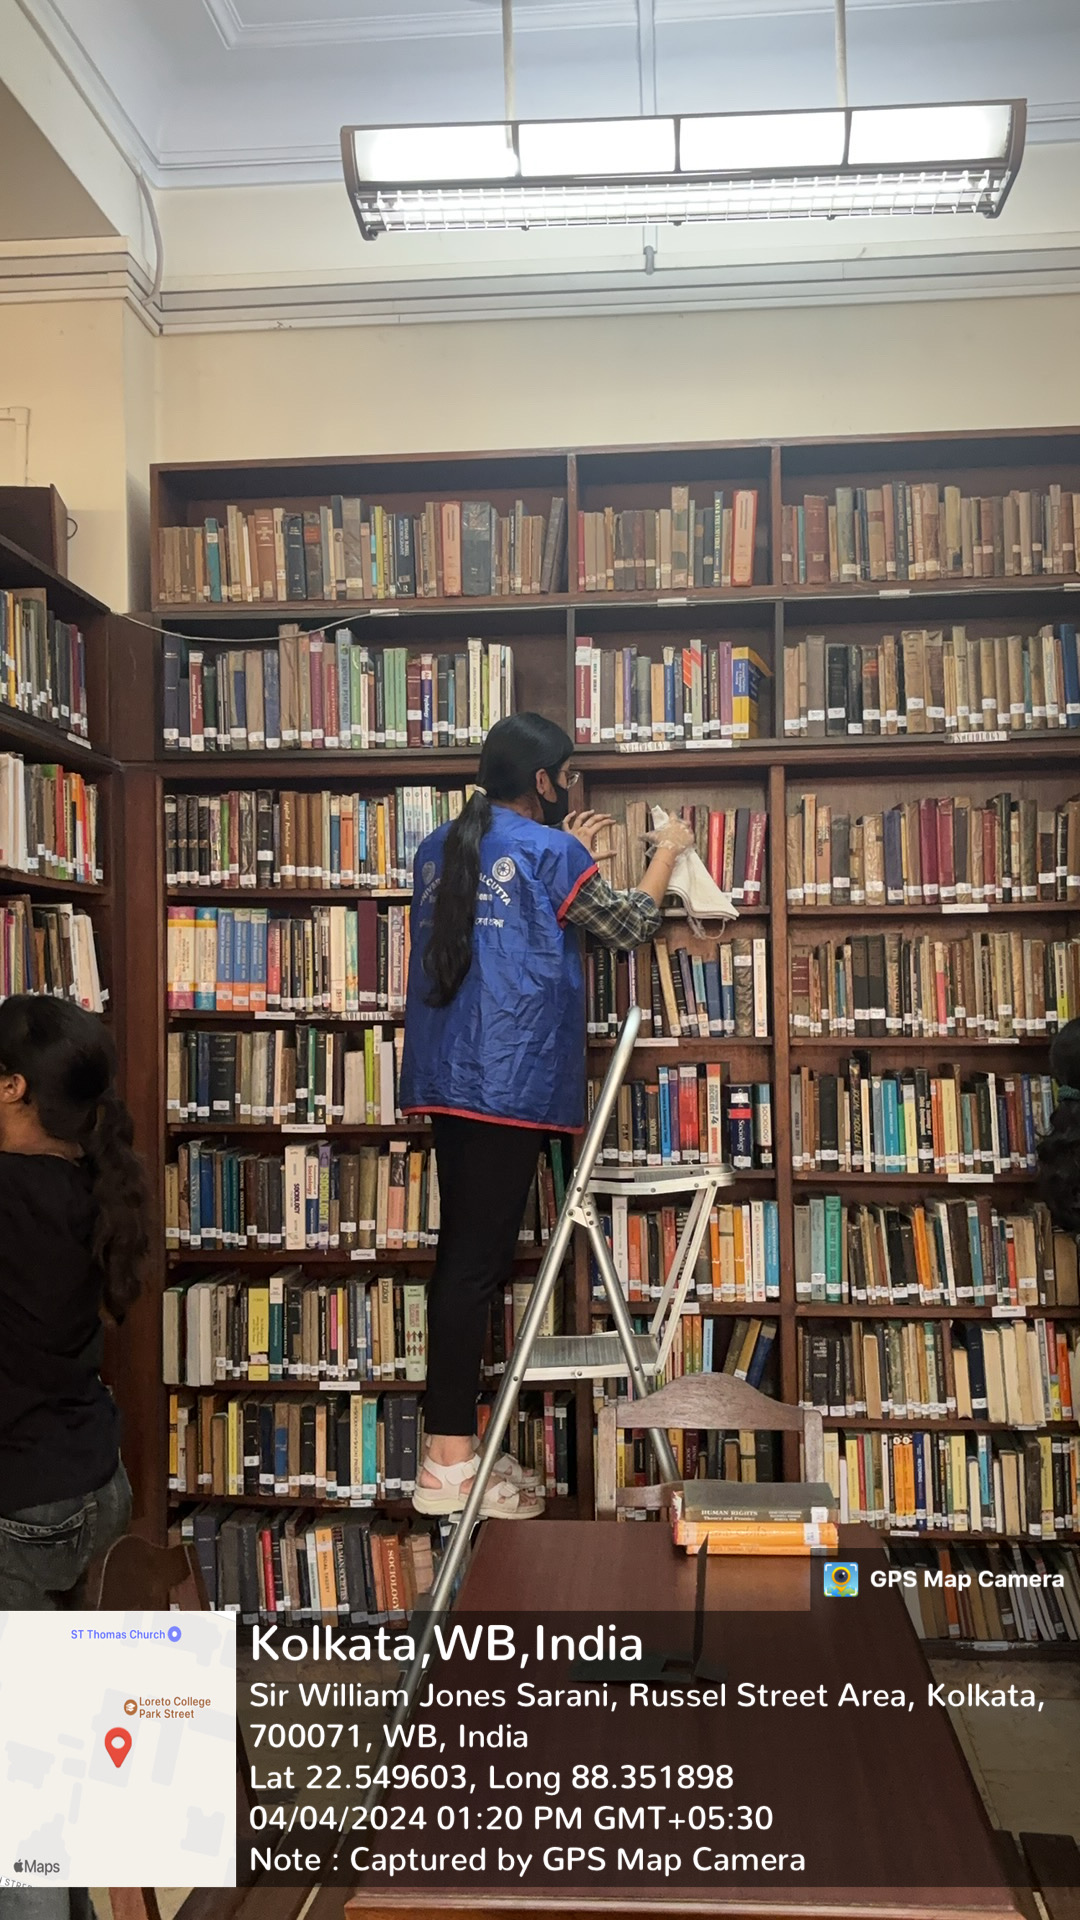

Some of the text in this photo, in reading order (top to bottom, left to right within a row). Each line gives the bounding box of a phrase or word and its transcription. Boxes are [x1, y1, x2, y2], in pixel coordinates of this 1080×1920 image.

[737, 1119, 746, 1153] Sociology
[762, 1105, 770, 1143] SOCIOLOGY
[319, 1172, 329, 1219] SOCIOLOGY
[337, 1541, 349, 1601] HUMAN SOCIETIES
[387, 1549, 400, 1610] SOCIOLOGY
